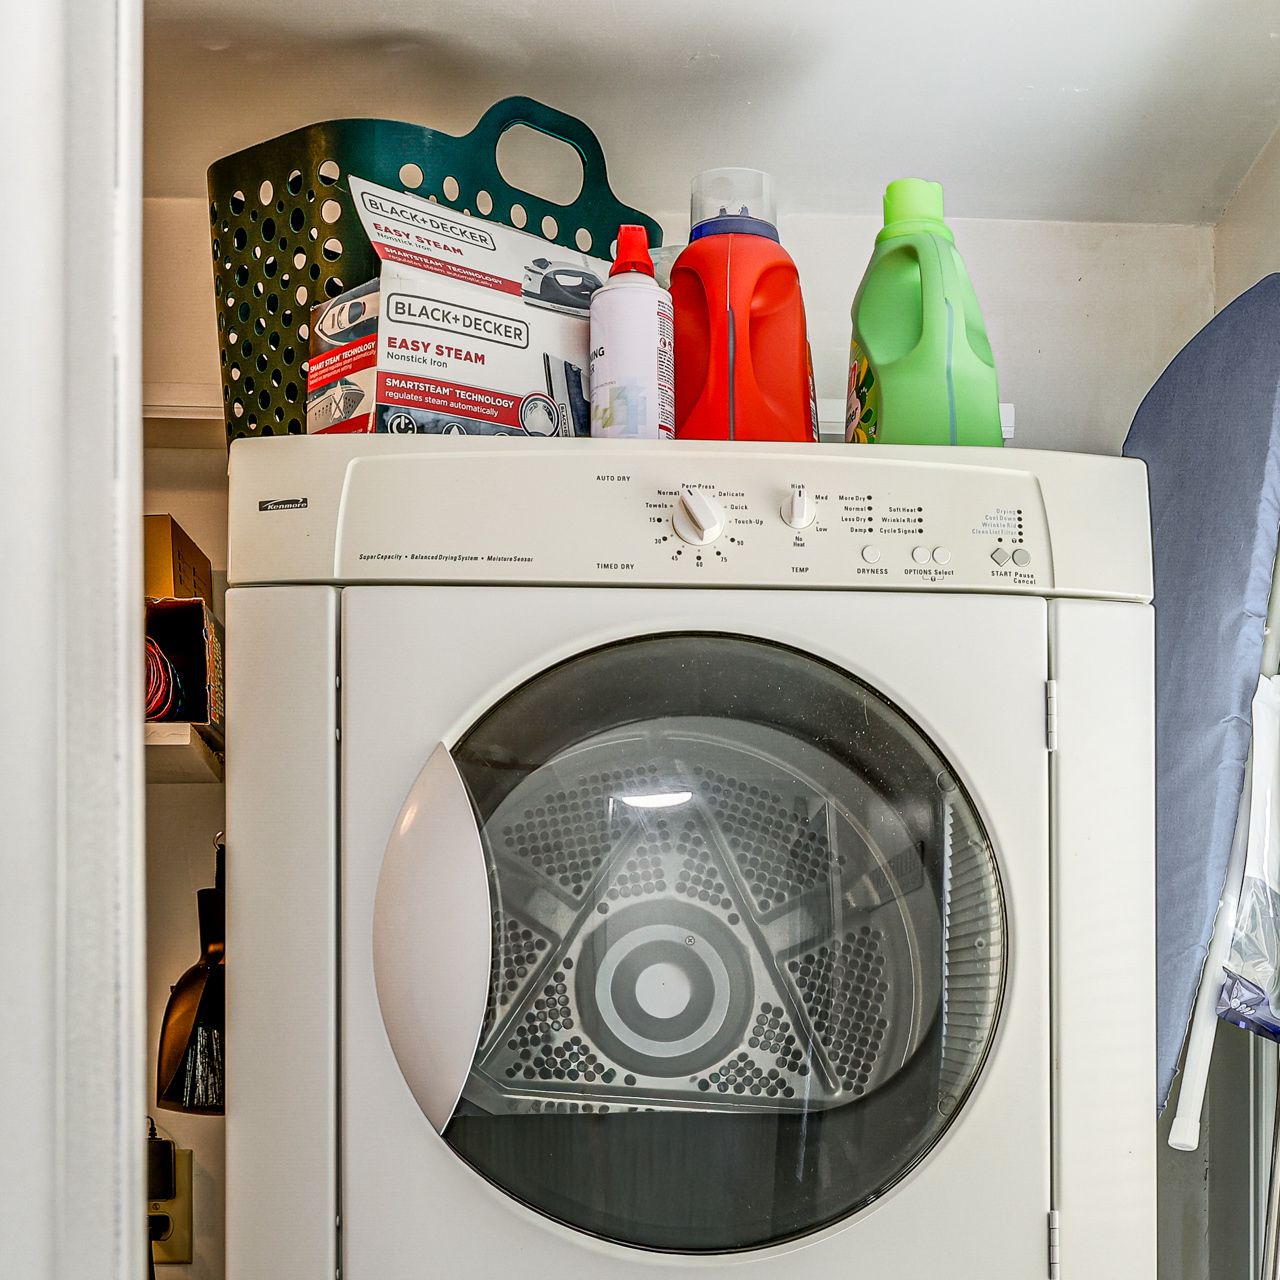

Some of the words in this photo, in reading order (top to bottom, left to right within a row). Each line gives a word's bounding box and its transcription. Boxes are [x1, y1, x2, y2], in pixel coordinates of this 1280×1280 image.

[368, 197, 492, 247] BLACK+DECKER
[373, 222, 411, 240] EASY
[415, 234, 465, 256] STEAM
[377, 231, 414, 247] Nonstick
[446, 264, 503, 285] TECHNOLOGY
[394, 301, 524, 342] BLACK+DECKER
[342, 341, 376, 360] TECHNOLOGY
[386, 351, 428, 367] Nonstick
[430, 357, 448, 369] Iron
[387, 336, 432, 354] EASY
[435, 343, 486, 365] STEAM
[385, 389, 423, 404] regulates
[424, 395, 448, 407] steam
[449, 399, 499, 418] automatically
[455, 388, 515, 409] TECHNOLOGY
[265, 501, 308, 511] Kenmore
[596, 562, 619, 570] TIMED
[904, 568, 933, 576] OPTIONS
[991, 570, 1012, 578] START
[1014, 571, 1034, 579] Pause
[1013, 577, 1036, 585] Cancel
